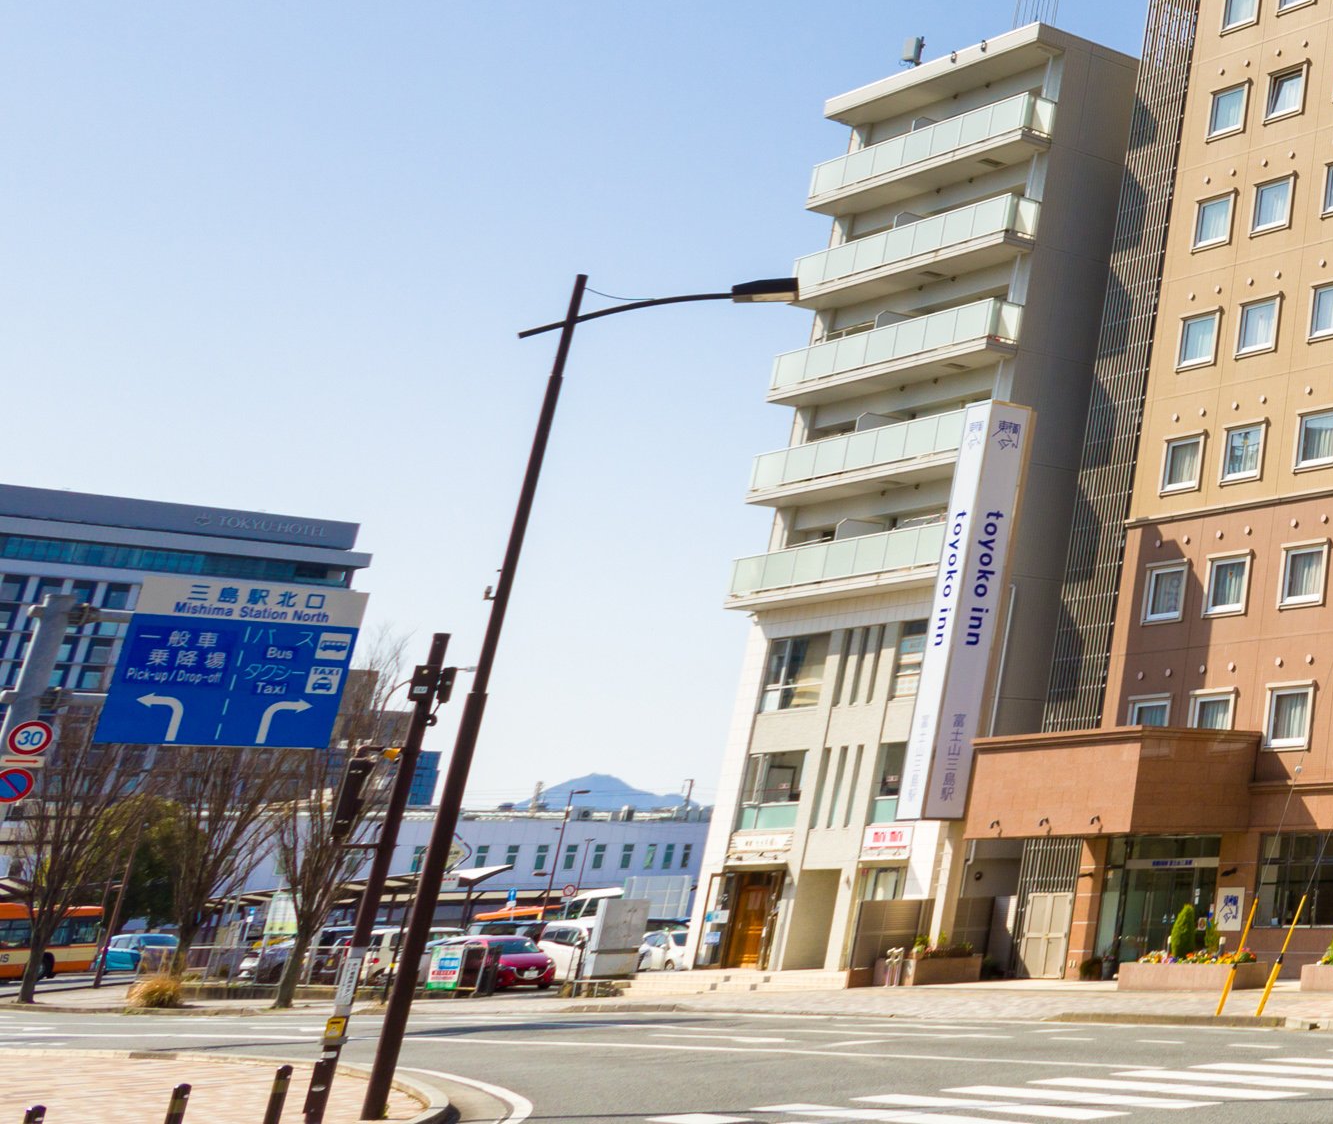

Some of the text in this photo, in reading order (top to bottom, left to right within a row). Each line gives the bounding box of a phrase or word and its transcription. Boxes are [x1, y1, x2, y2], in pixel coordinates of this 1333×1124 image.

[934, 509, 967, 647] toyoko inn
[965, 510, 1004, 647] toyoko inn
[187, 584, 326, 609] 三島駅北口
[173, 601, 330, 624] Mishima Station North
[140, 630, 220, 648] 一般車
[253, 628, 315, 647] バス
[146, 648, 228, 669] 乗降場
[266, 647, 293, 660] Bus
[244, 663, 306, 680] タクシー
[313, 668, 342, 676] TAXI
[256, 682, 287, 695] Taxi
[17, 730, 44, 747] 30
[940, 713, 968, 802] 富士山三島駅
